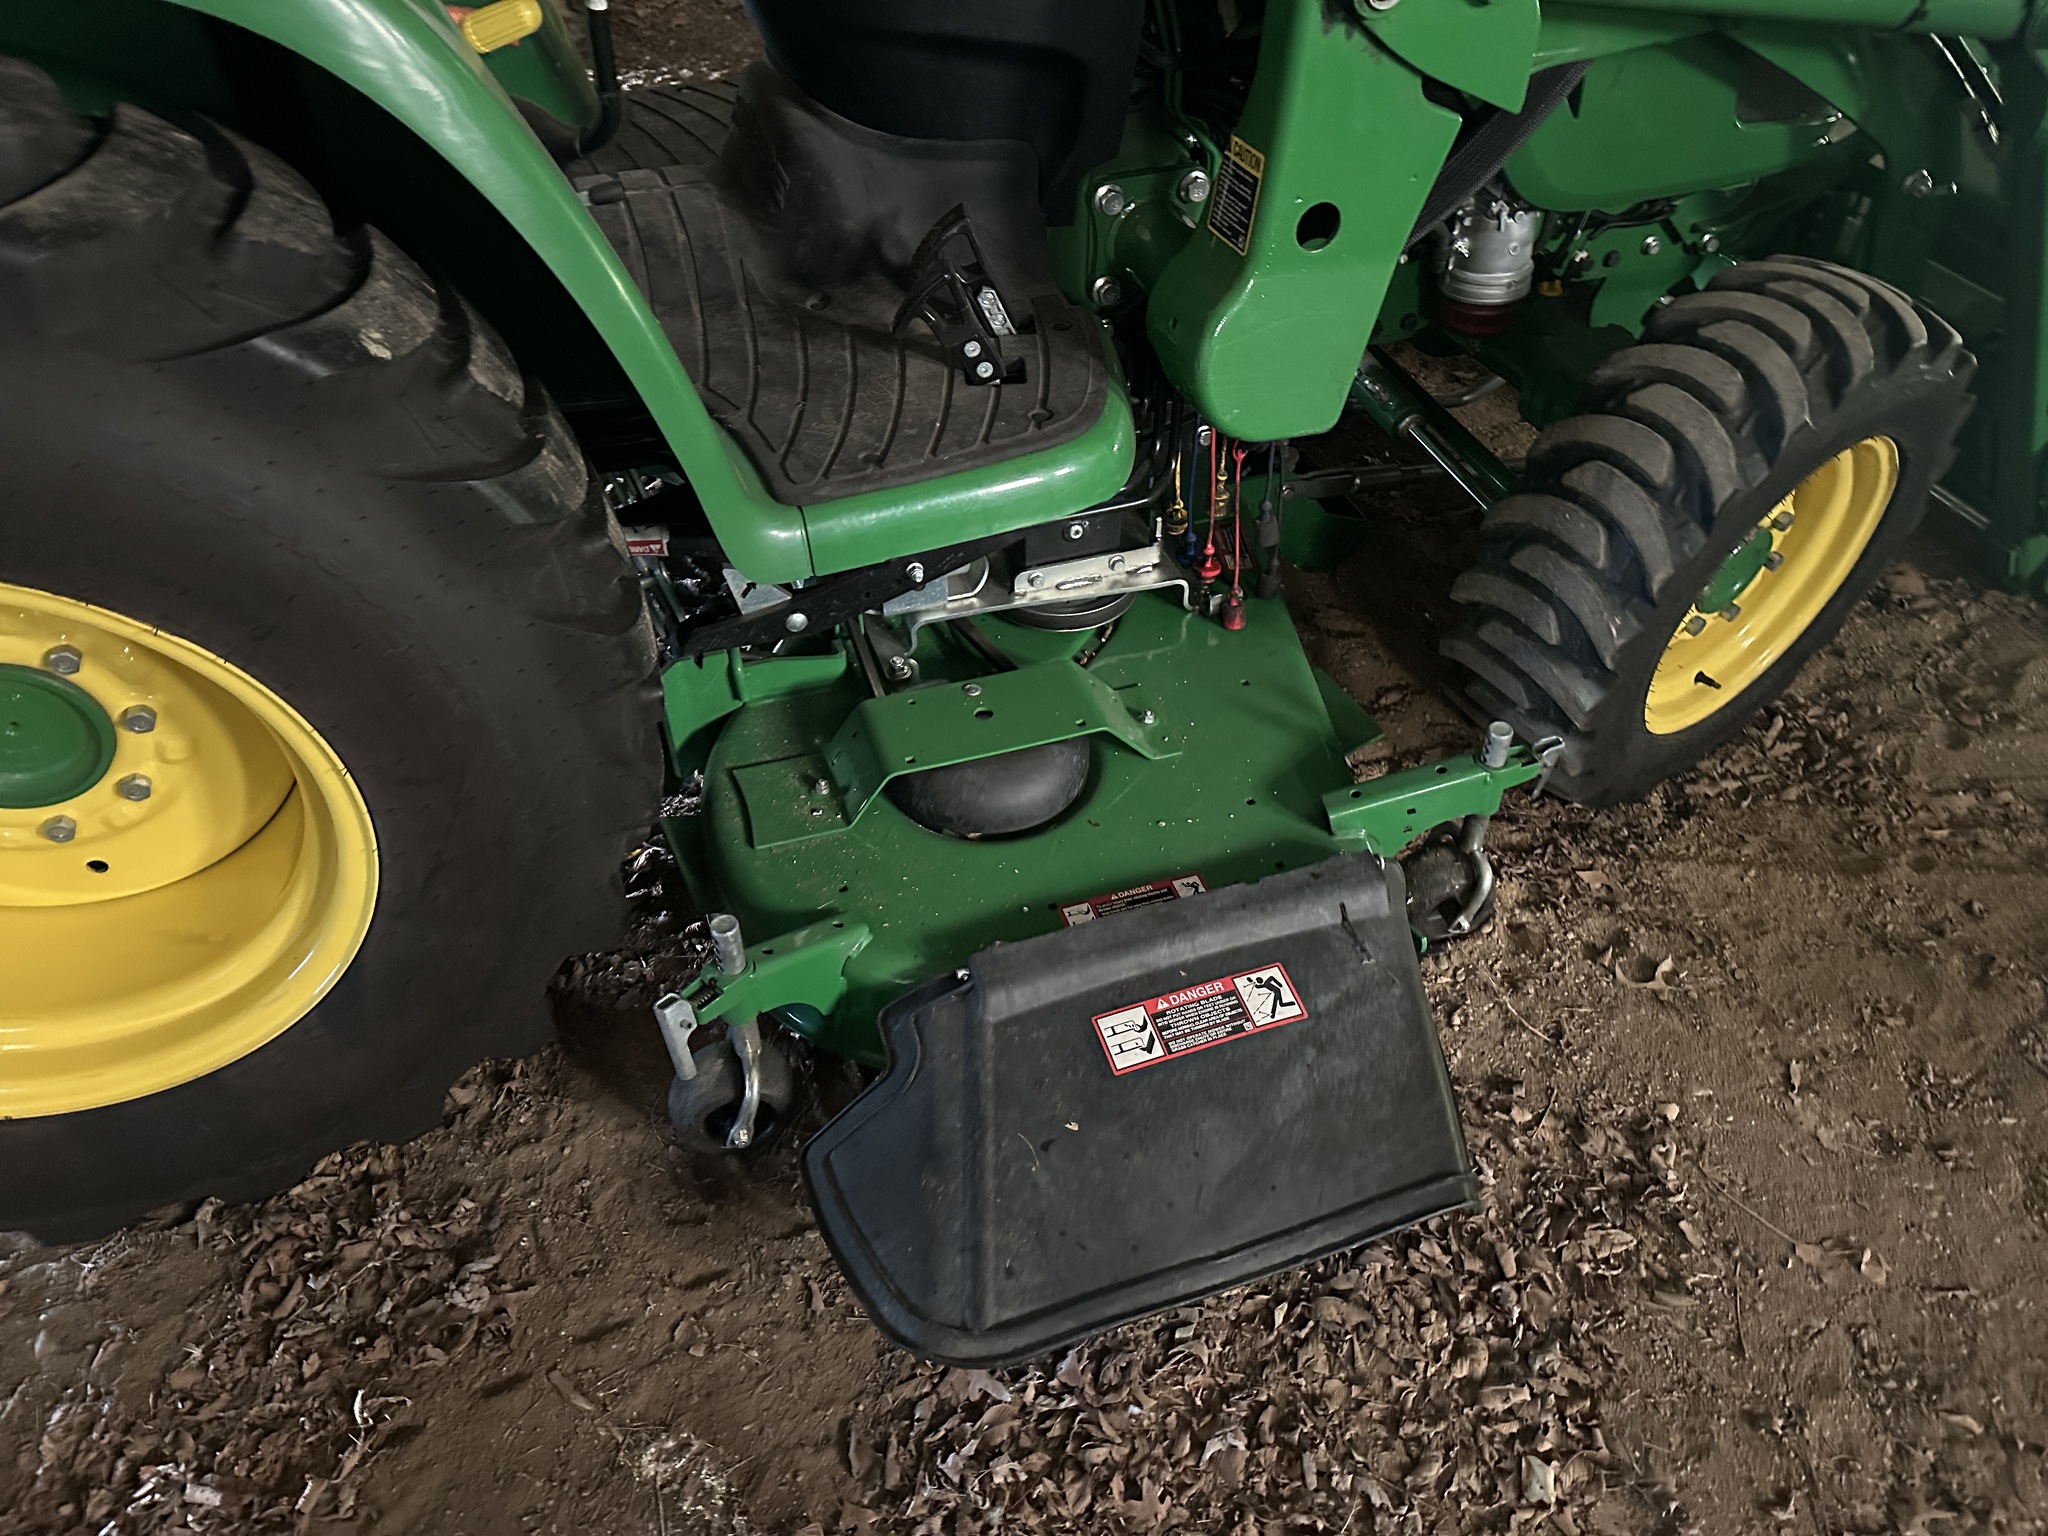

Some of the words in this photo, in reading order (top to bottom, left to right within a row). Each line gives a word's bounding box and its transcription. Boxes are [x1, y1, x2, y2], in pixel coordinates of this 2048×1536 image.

[1233, 140, 1263, 174] CAUTION
[1118, 885, 1153, 898] DANGER
[1169, 982, 1225, 1005] DANGER
[1166, 1002, 1199, 1015] ROTATING
[1200, 995, 1223, 1005] BLADE
[1171, 1016, 1199, 1028] THROWN
[1200, 1007, 1231, 1019] OBJECTS
